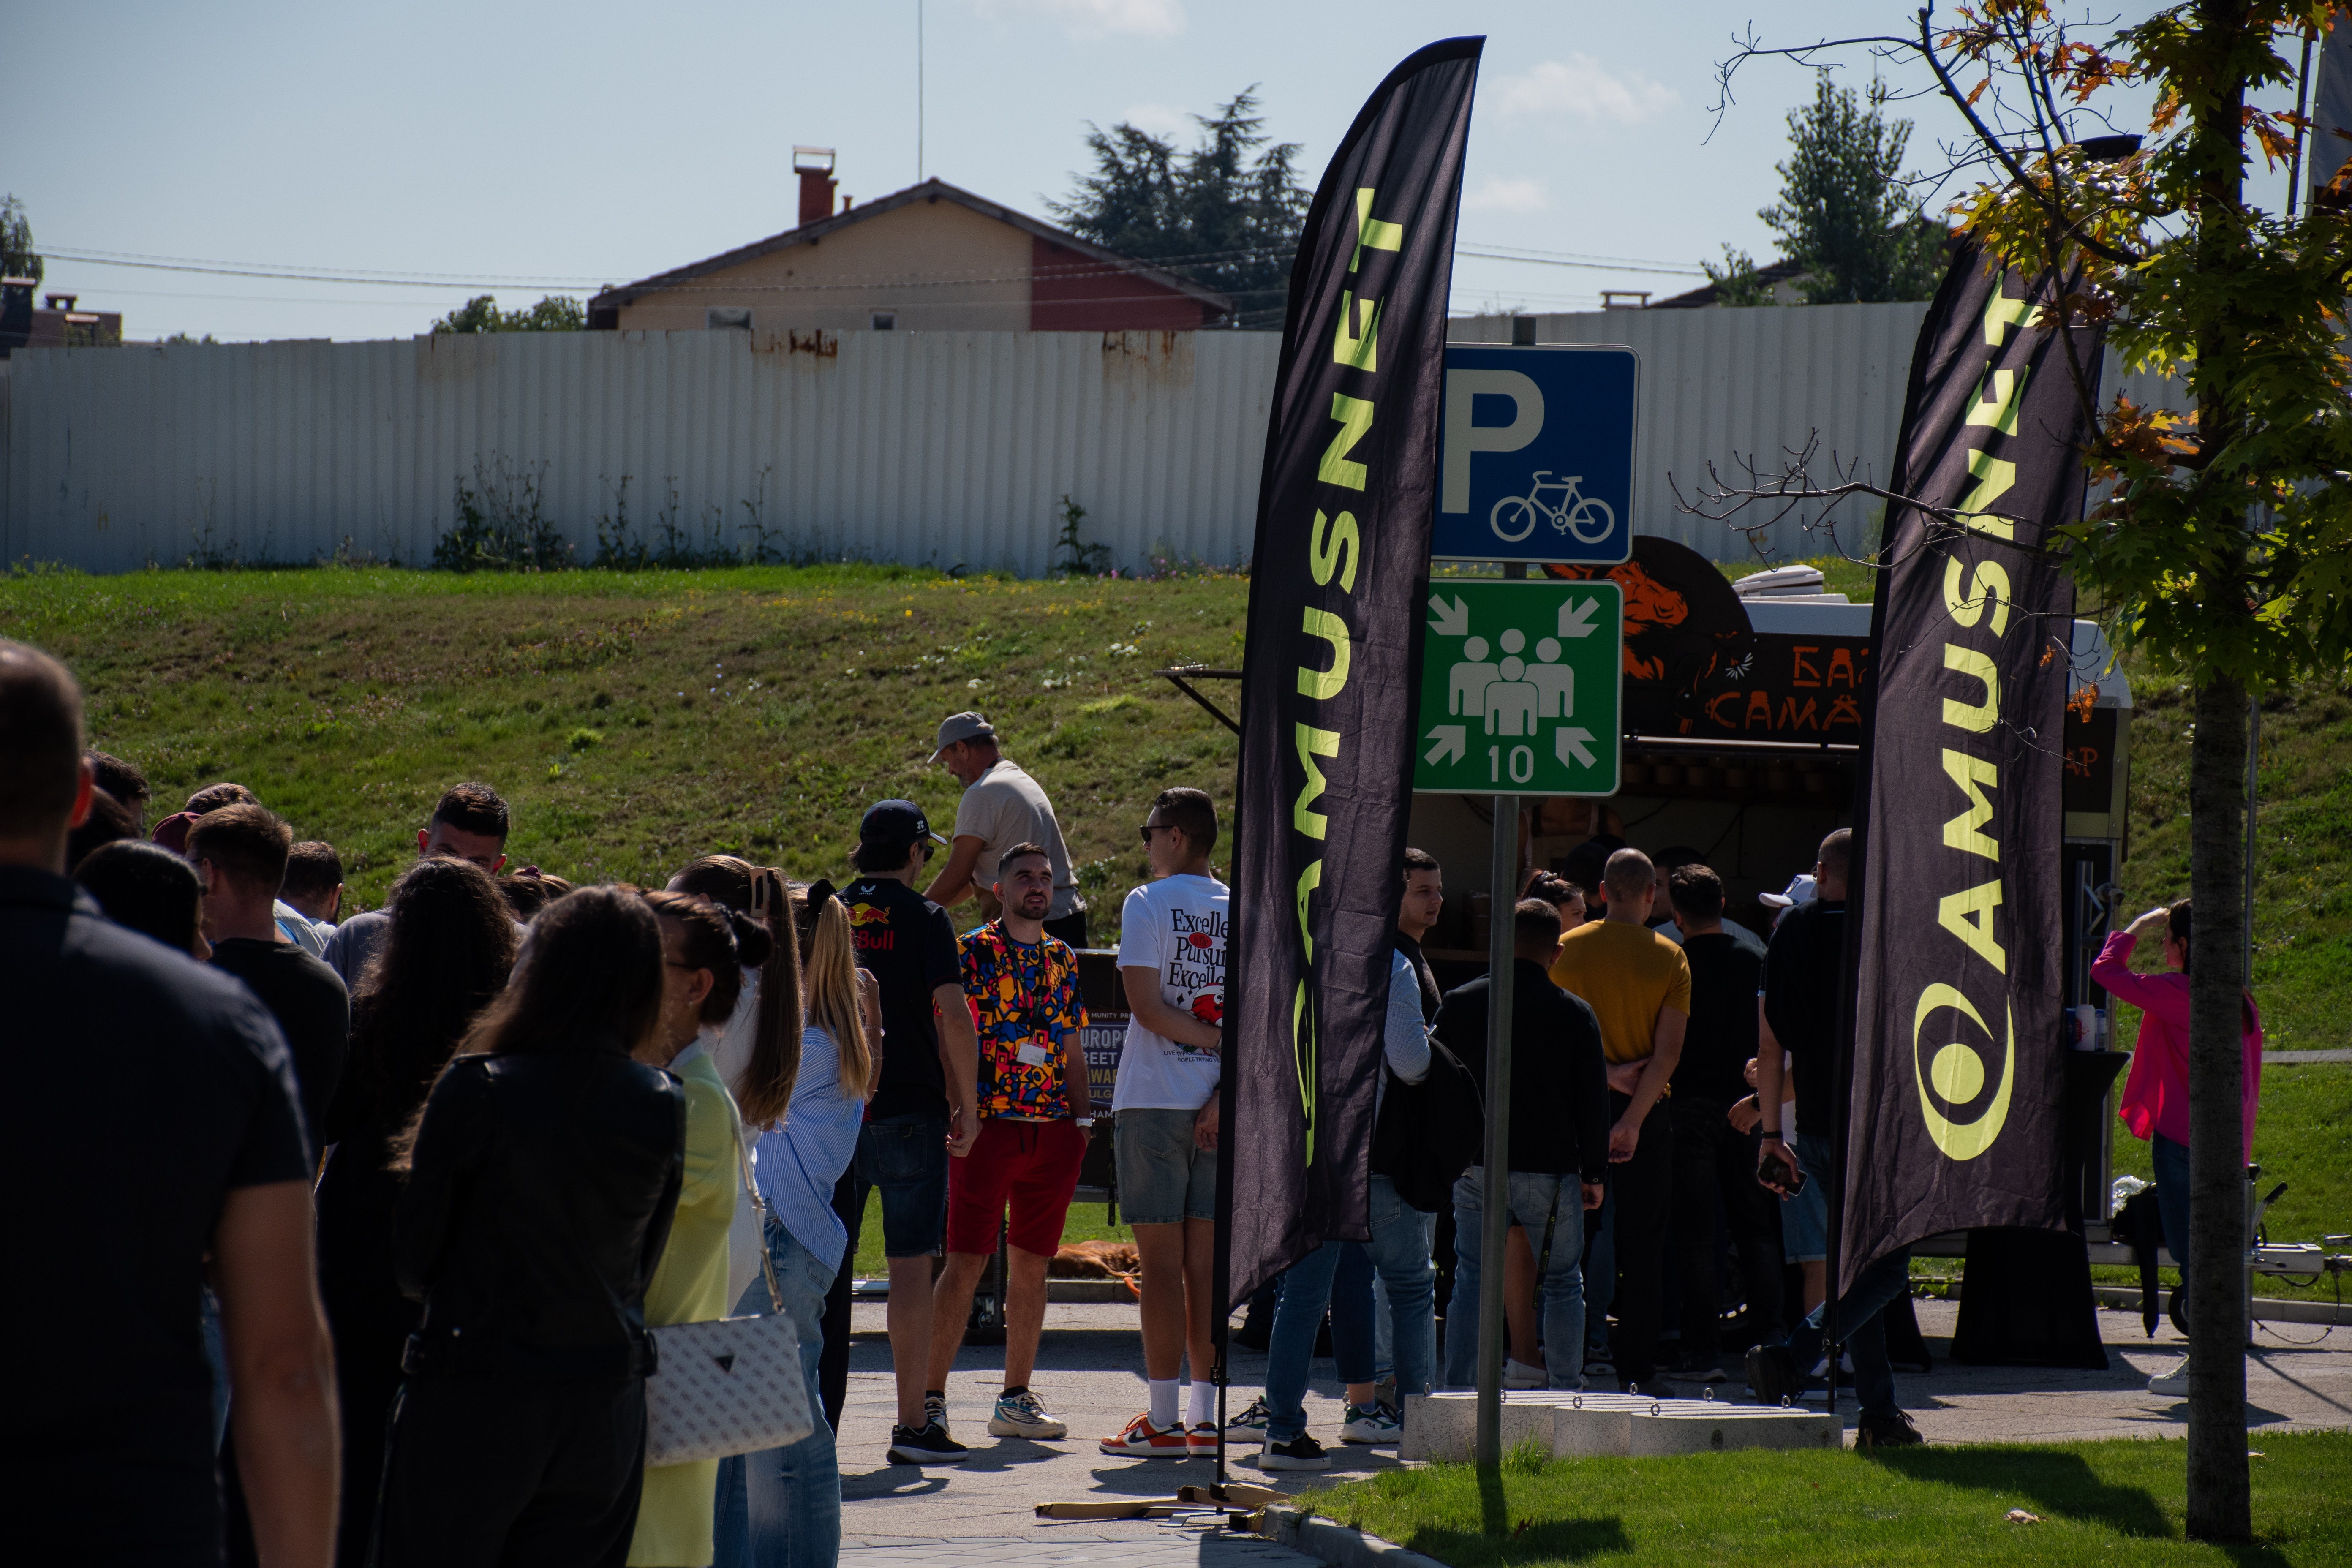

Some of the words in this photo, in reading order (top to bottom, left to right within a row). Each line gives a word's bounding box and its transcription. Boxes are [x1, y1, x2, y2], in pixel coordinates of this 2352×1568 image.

[1441, 368, 1545, 514] P
[1294, 188, 1402, 966] AMUSNET
[1938, 270, 2044, 975] AMUSNET
[1488, 745, 1534, 783] 10
[858, 930, 894, 950] Bull
[1089, 1089, 1113, 1098] ULG
[1364, 1421, 1375, 1429] FILA
